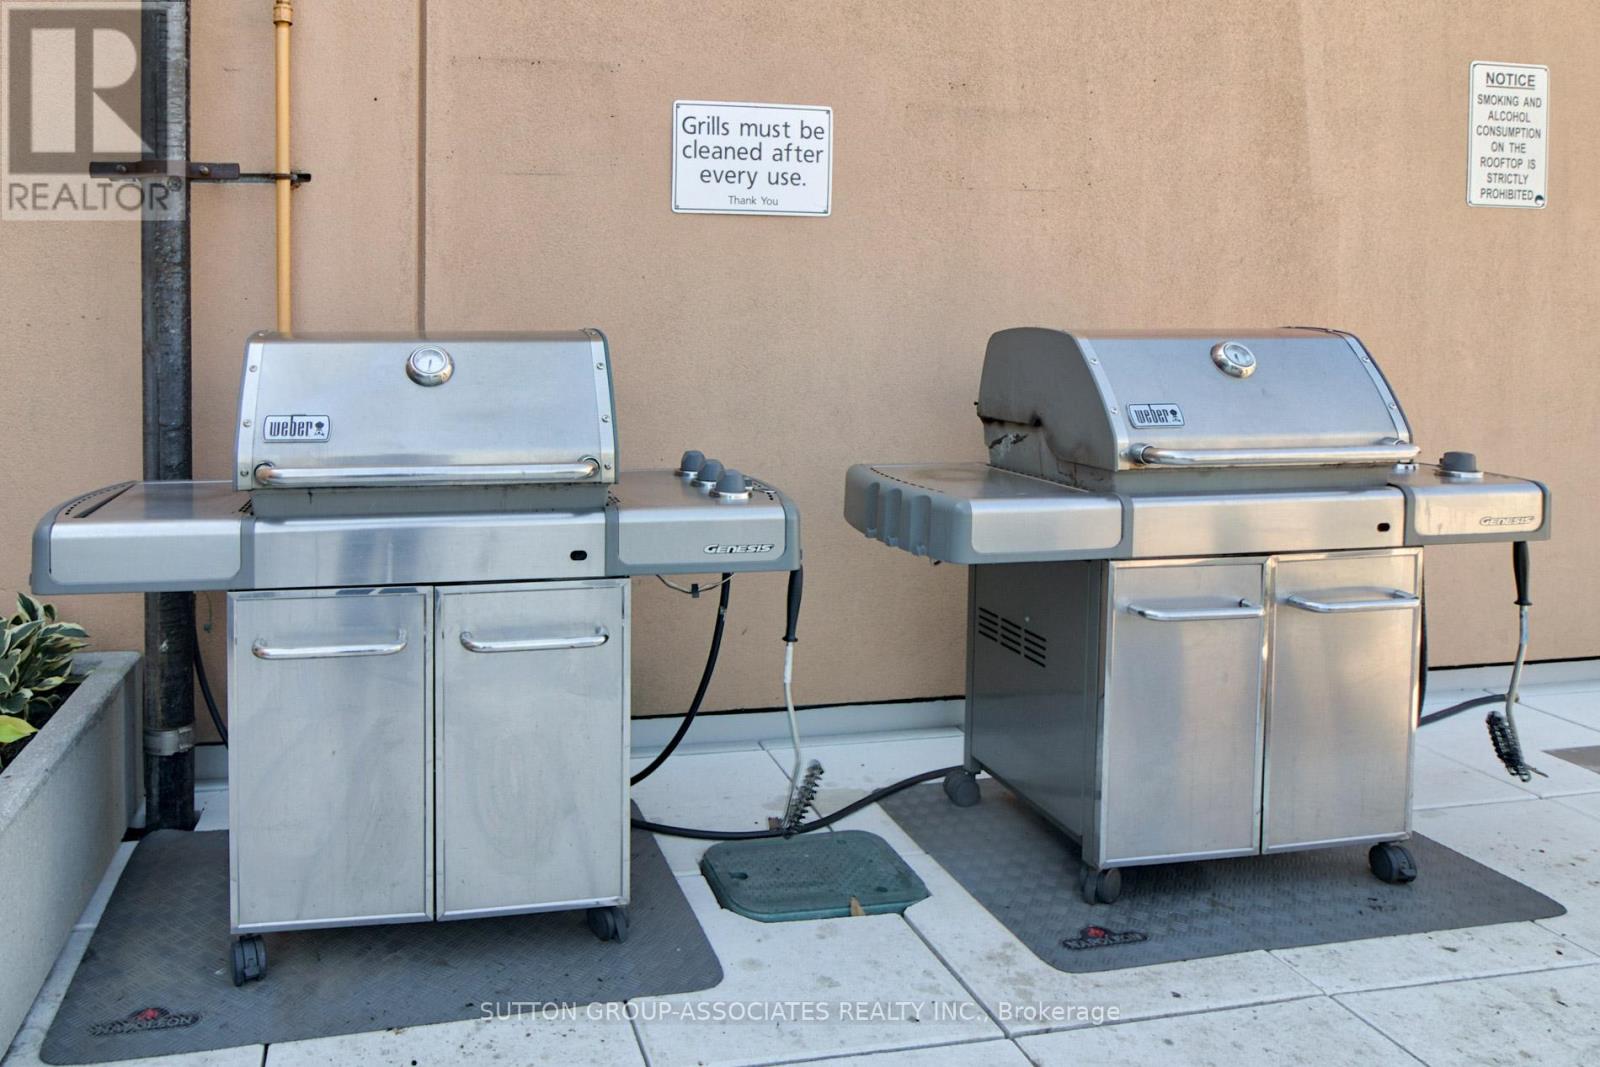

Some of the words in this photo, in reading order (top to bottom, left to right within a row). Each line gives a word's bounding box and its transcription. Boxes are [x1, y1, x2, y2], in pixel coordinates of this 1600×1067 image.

[1486, 72, 1536, 87] NOTICE
[1477, 93, 1519, 107] SMOKING
[1523, 97, 1542, 108] AND
[1488, 110, 1531, 123] ALCOHOL
[682, 116, 730, 136] Grills
[740, 121, 791, 139] must
[800, 120, 825, 140] be
[1476, 125, 1541, 139] CONSUMPTION
[682, 140, 762, 161] cleaned
[772, 143, 824, 163] after
[1490, 141, 1504, 153] ON
[1509, 142, 1527, 154] THE
[1480, 156, 1523, 169] ROOFTOP
[1527, 159, 1536, 169] IS
[700, 169, 758, 189] every
[768, 171, 807, 186] use.
[1486, 172, 1529, 185] STRICTLY
[728, 195, 757, 206] Thank
[761, 196, 779, 206] You
[1480, 188, 1534, 201] PROHIBITED
[1134, 404, 1169, 424] weber
[270, 414, 313, 437] weber
[704, 544, 775, 554] GENESIS
